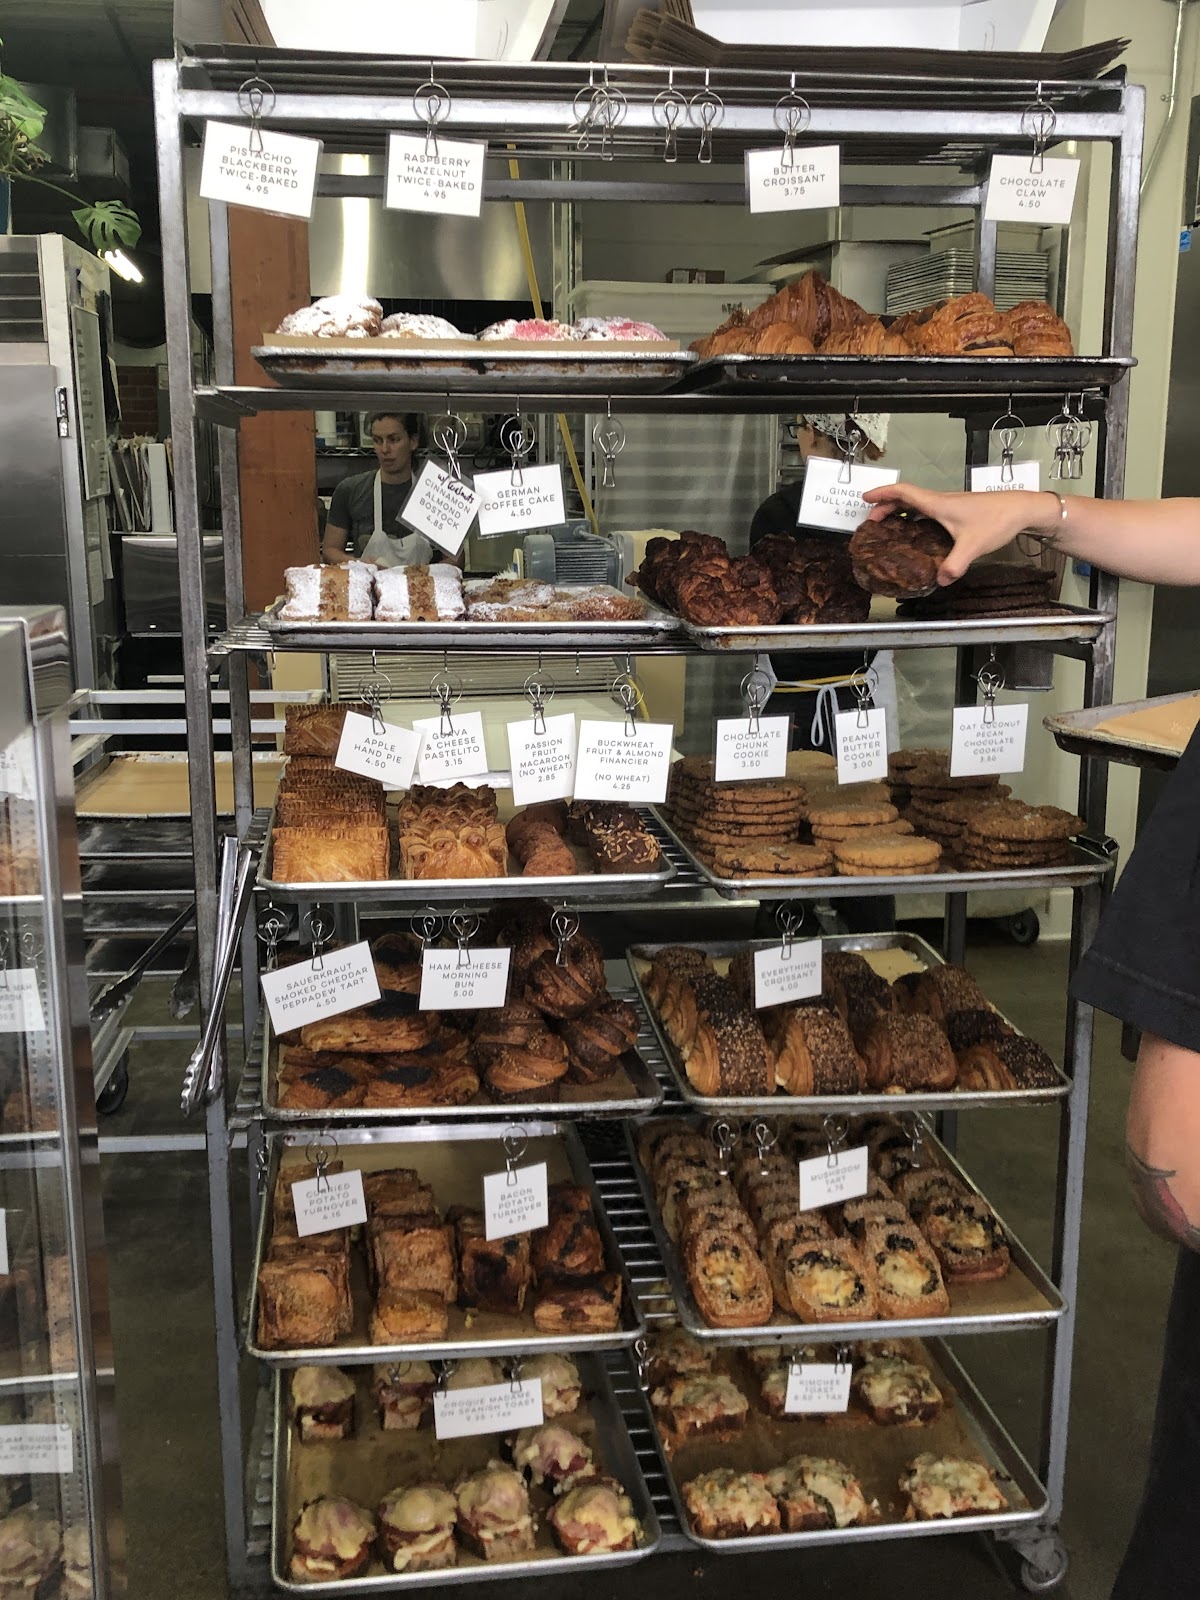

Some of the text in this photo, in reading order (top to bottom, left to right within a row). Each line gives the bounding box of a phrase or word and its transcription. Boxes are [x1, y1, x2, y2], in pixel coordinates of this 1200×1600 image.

[230, 146, 292, 165] PISTACHIO
[404, 153, 470, 167] RASPBERRY
[222, 156, 297, 176] BLACKBERRY
[407, 165, 465, 178] HAZELNUT
[773, 164, 815, 175] BUTTER
[219, 166, 298, 188] TWICE-BAKED
[763, 174, 825, 187] CROISSANT
[1000, 177, 1066, 188] CHOCOLATE
[397, 175, 475, 191] TWICE-BAKED
[246, 184, 269, 194] 4.95
[424, 190, 446, 199] 4.95
[784, 187, 805, 196] 3.75
[1016, 189, 1046, 197] CLAW
[1019, 200, 1040, 208] 4.50
[497, 486, 540, 499] GERMAN
[829, 487, 862, 499] GINGE
[985, 483, 1025, 492] GINGER
[425, 479, 471, 514] CINNAMON
[425, 491, 461, 519] ALMOND
[484, 494, 555, 511] COFFEE CAKE
[815, 495, 875, 510] PULL-APAR
[419, 498, 460, 530] BOSTOCK
[511, 508, 532, 517] 4.50
[835, 508, 857, 518] 4.50
[426, 515, 443, 530] 4.85
[980, 720, 1020, 729] COCONUT
[432, 729, 467, 740] GUAVA
[723, 731, 781, 741] CHOCOLATE
[842, 732, 880, 743] PEANUT
[364, 737, 396, 752] APPLE
[436, 736, 476, 749] CHEESE
[525, 738, 562, 750] PASSION
[597, 740, 654, 748] BUCKWHEAT
[735, 741, 769, 750] CHUNK
[843, 741, 880, 752] BUTTER
[963, 737, 1014, 747] CHOCOLATE
[354, 744, 402, 764] HAND PIE
[425, 745, 480, 760] PASTELITO
[532, 748, 556, 757] FRUIT
[625, 750, 664, 758] ALMOND
[733, 750, 769, 759] COOKIE
[843, 750, 880, 761] COOKIE
[973, 746, 1004, 755] COOKIE
[365, 757, 386, 768] 4.50
[445, 758, 463, 767] 3.15
[520, 754, 570, 768] MACAROON
[600, 757, 649, 765] FINANCIER
[741, 760, 761, 768] 3.50
[853, 760, 873, 769] 3.00
[519, 761, 573, 778] (NO WHEAT)
[538, 774, 555, 782] 2.85
[594, 772, 650, 783] (NO WHEAT)
[465, 962, 502, 970] CHEESE
[761, 961, 816, 979] EVERYTHING
[286, 962, 352, 990] SAUERKRAUT
[442, 971, 488, 979] MORNING
[764, 970, 813, 987] CROISSANT
[274, 967, 368, 1004] SMOKED CHEDDAR
[282, 977, 365, 1010] PEPPADEW TART
[316, 997, 337, 1008] 4.50
[309, 1191, 349, 1206] POTATO
[500, 1188, 532, 1201] BACON
[303, 1198, 358, 1216] TURNOVER
[499, 1195, 535, 1209] POTATO
[493, 1201, 541, 1219] TURNOVER
